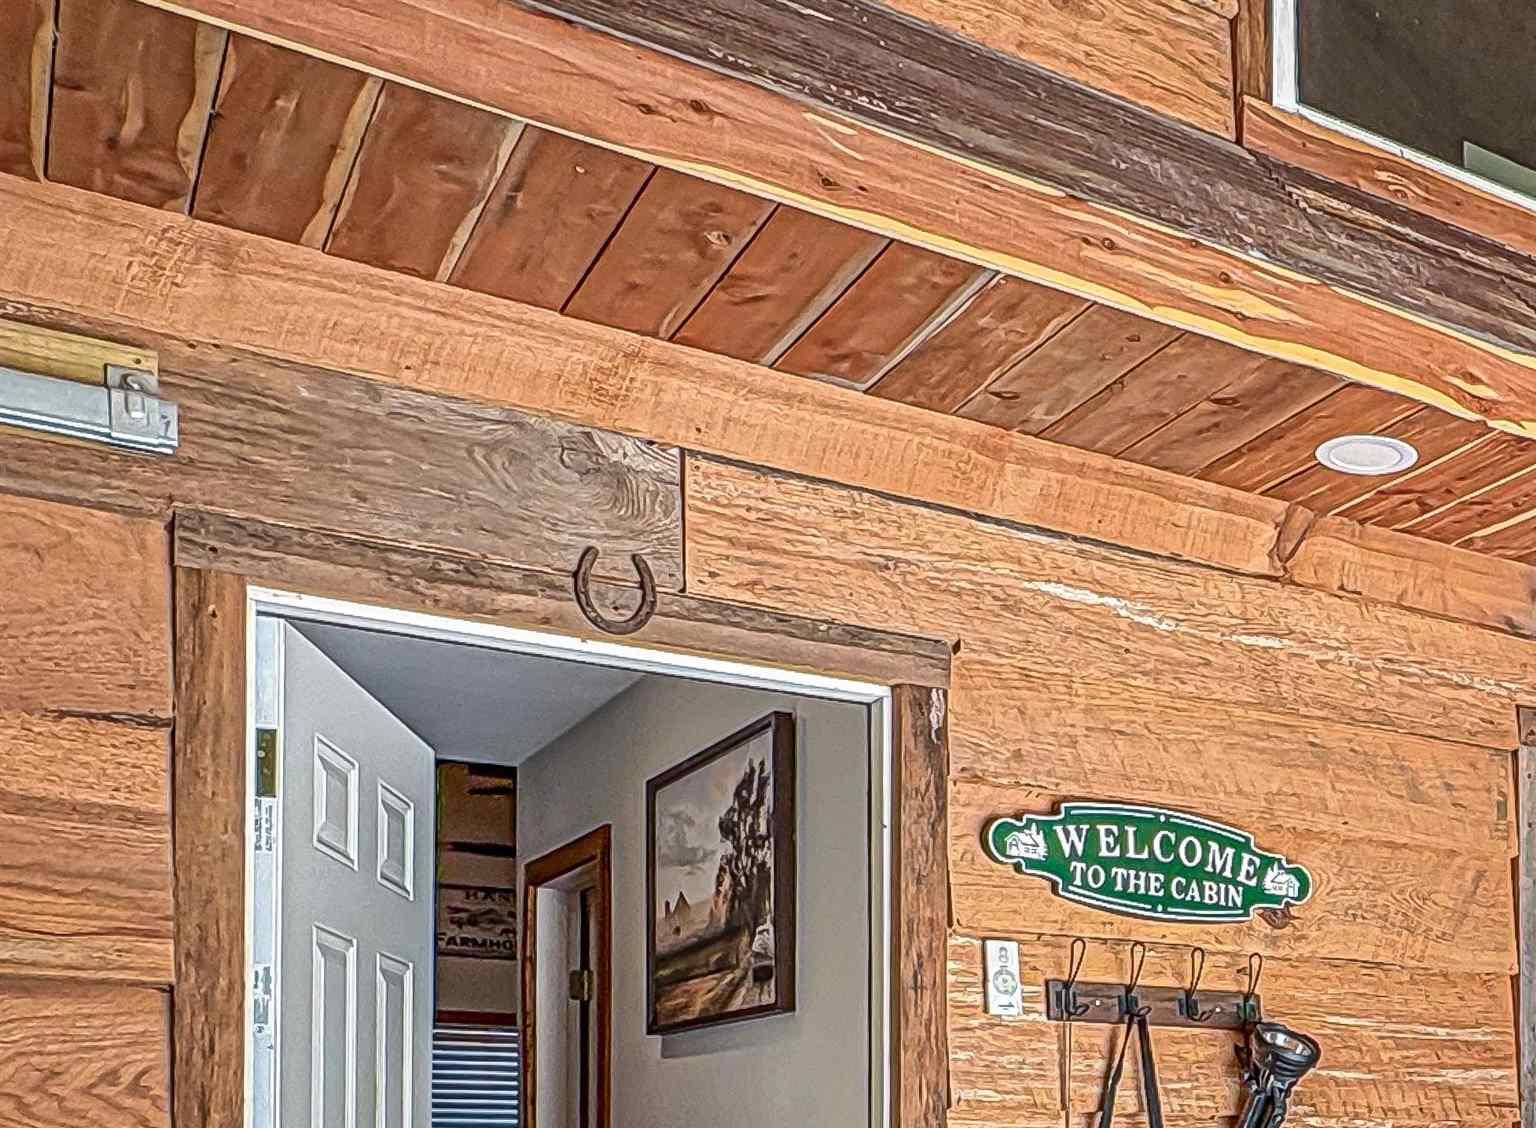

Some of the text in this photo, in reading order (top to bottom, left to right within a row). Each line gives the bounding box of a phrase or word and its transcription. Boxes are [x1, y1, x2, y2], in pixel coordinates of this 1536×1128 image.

[1053, 824, 1260, 887] WELCOME
[1070, 861, 1244, 908] TO THE CABIN
